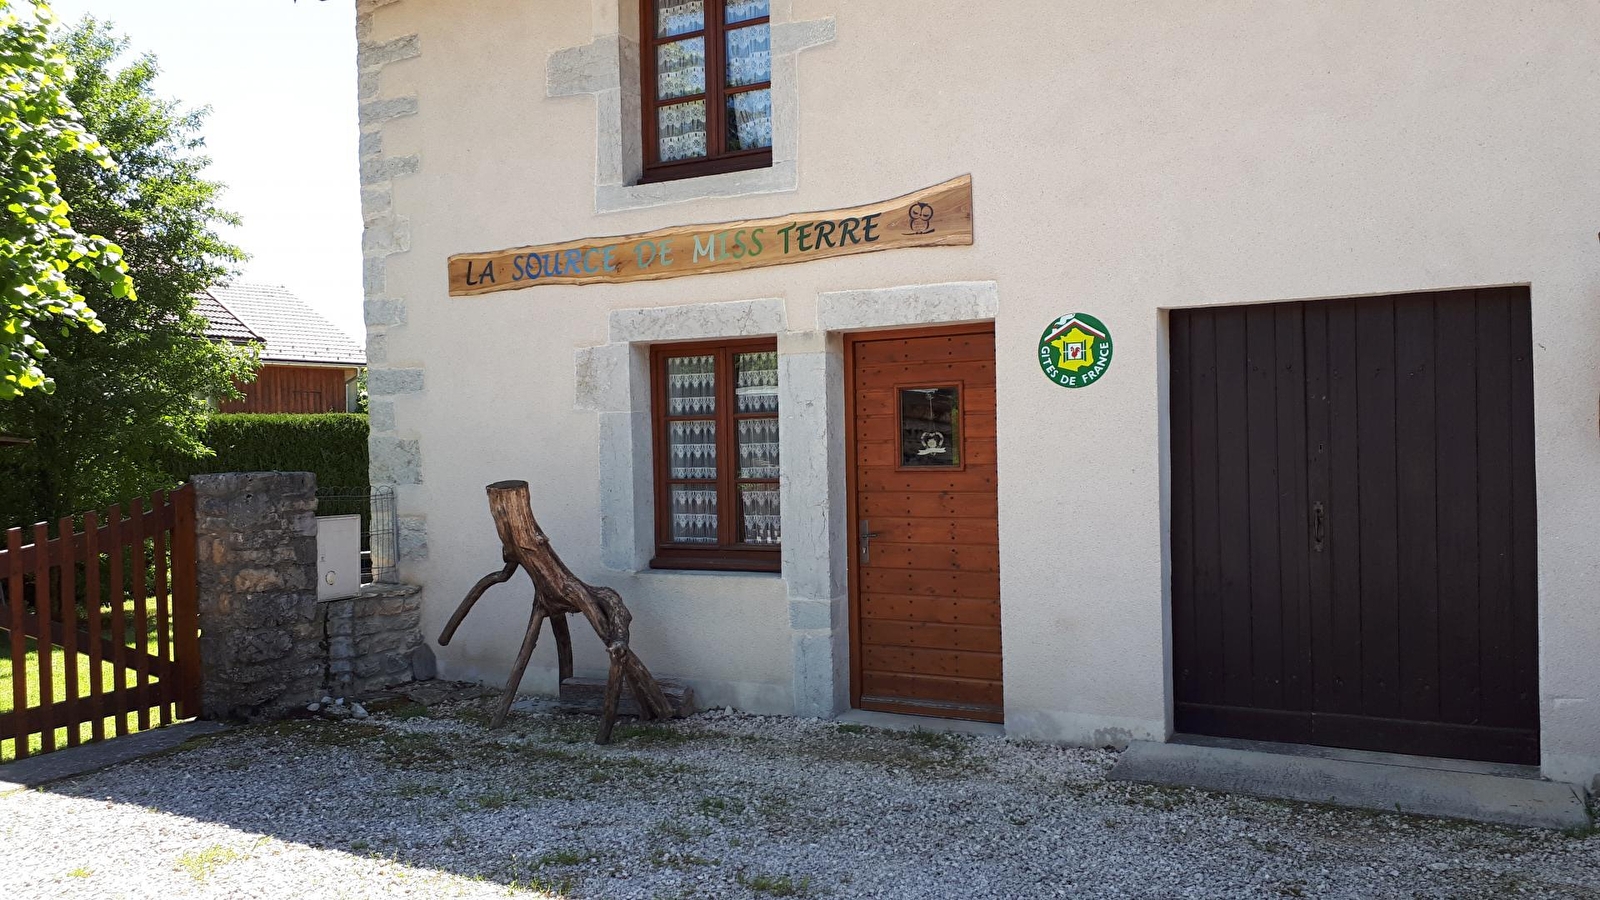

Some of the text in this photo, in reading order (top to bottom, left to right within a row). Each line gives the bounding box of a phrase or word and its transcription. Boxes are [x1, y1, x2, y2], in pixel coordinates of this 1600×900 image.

[465, 213, 882, 286] LA SOURCE DE MISS TERRE
[1041, 342, 1109, 386] GITES DE FRANCE
